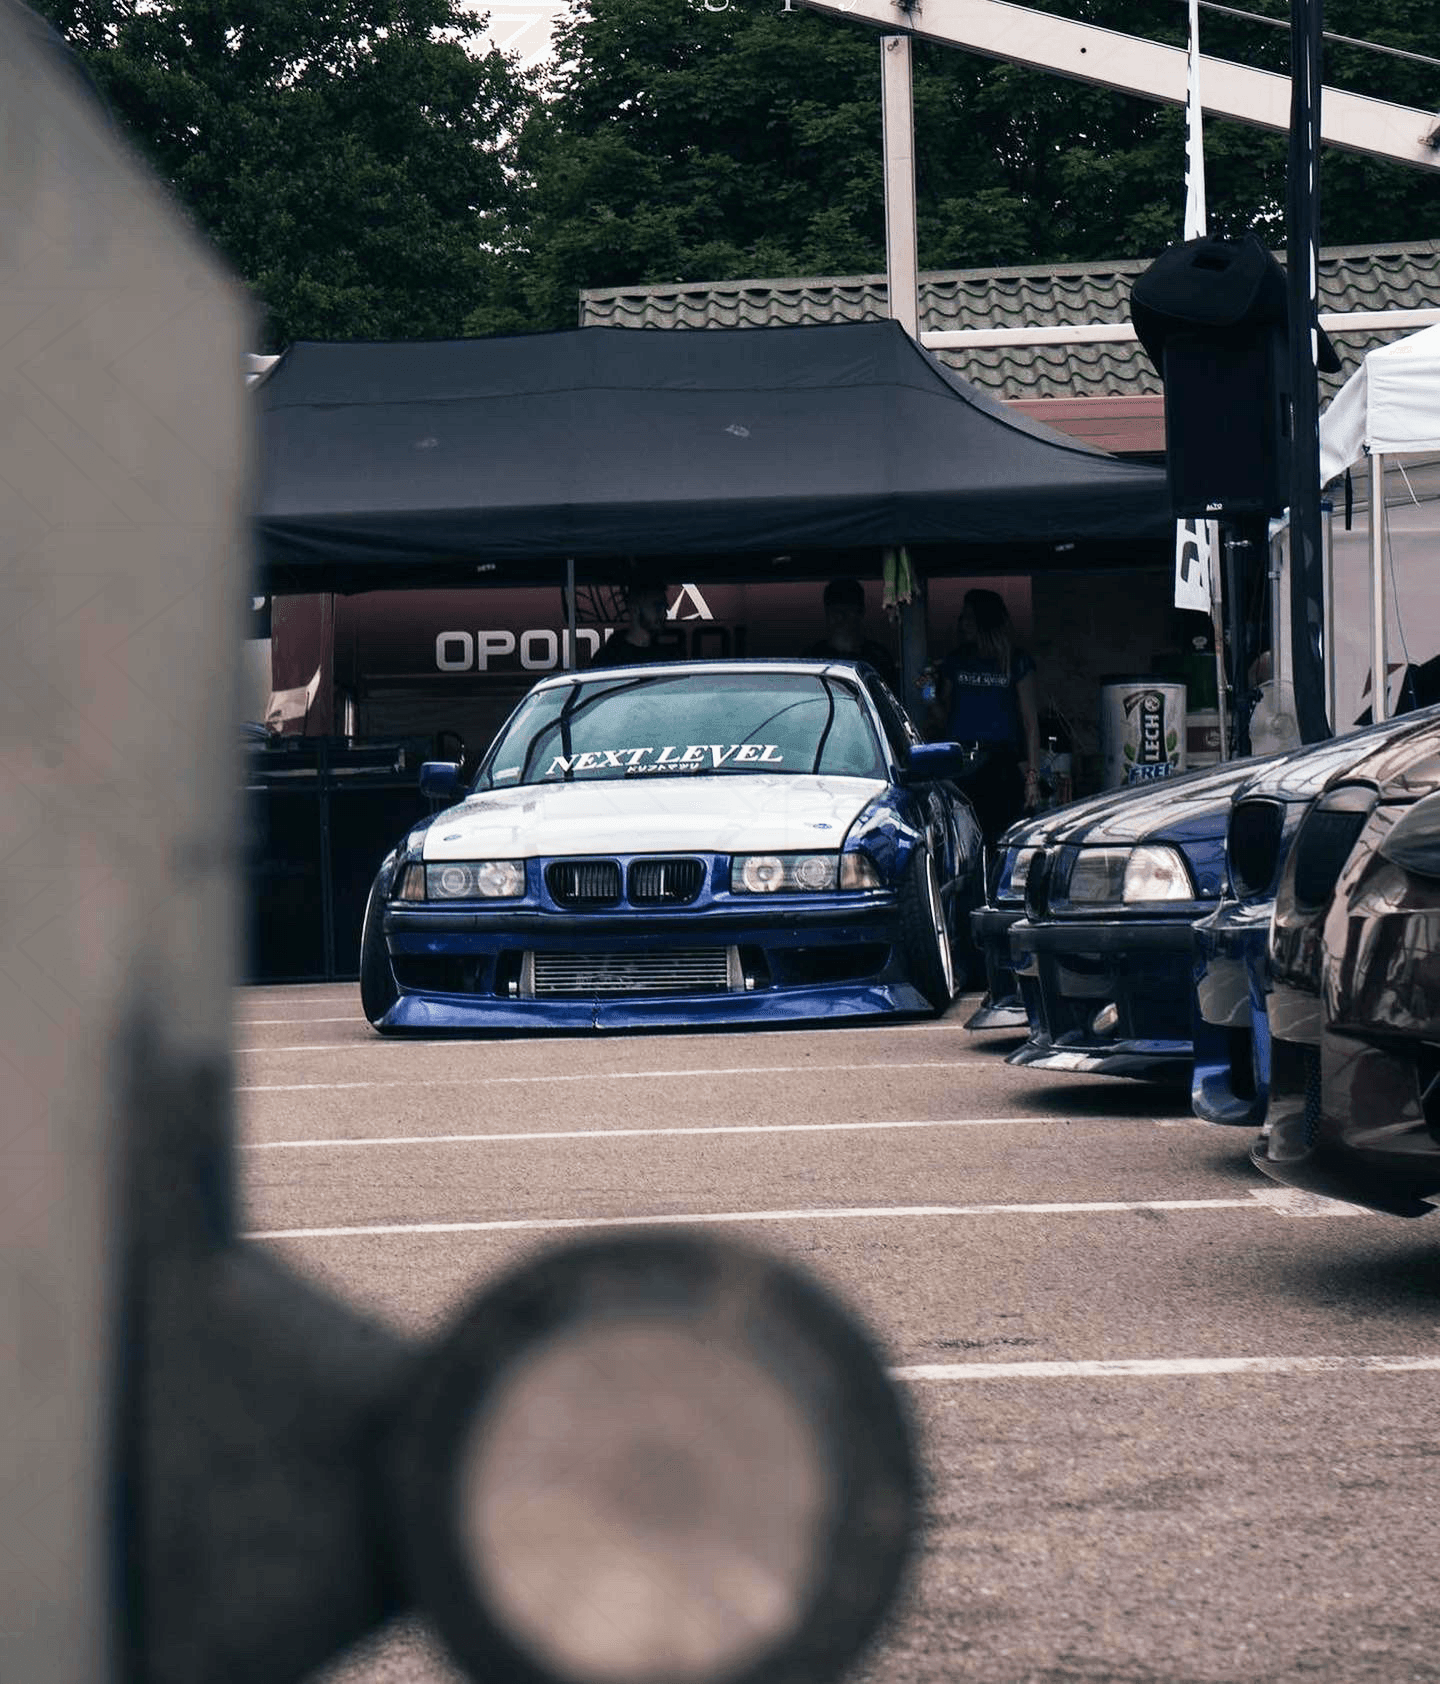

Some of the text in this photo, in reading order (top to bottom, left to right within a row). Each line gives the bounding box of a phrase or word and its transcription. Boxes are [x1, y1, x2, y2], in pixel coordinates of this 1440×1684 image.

[1144, 714, 1160, 761] LECH
[545, 744, 785, 775] NEXT LEVEL
